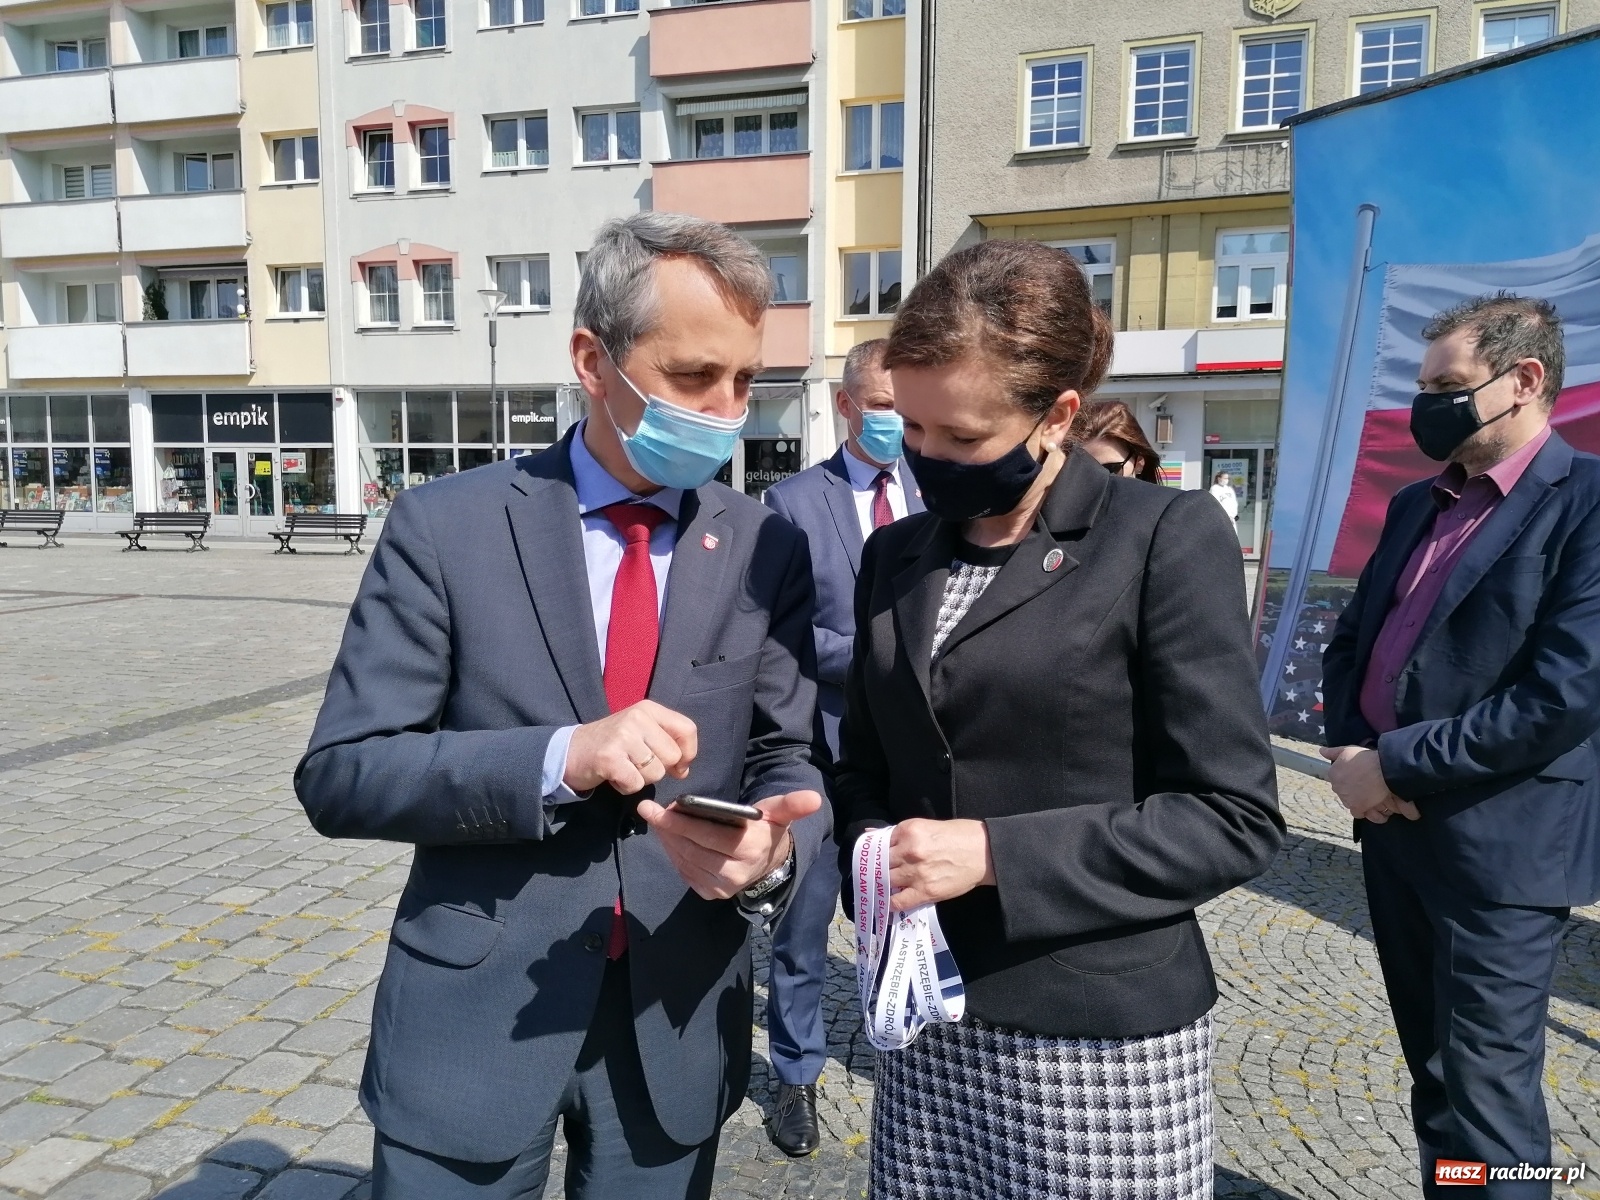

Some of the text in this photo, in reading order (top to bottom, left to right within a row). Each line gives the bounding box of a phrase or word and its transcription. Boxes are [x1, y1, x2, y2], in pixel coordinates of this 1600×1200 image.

[213, 404, 269, 428] empik
[511, 411, 555, 424] empik.com
[859, 834, 875, 933] WODZISŁAW ŚLĄSKI
[884, 938, 910, 1037] JASTRZĘBIE-ZDRÓJ
